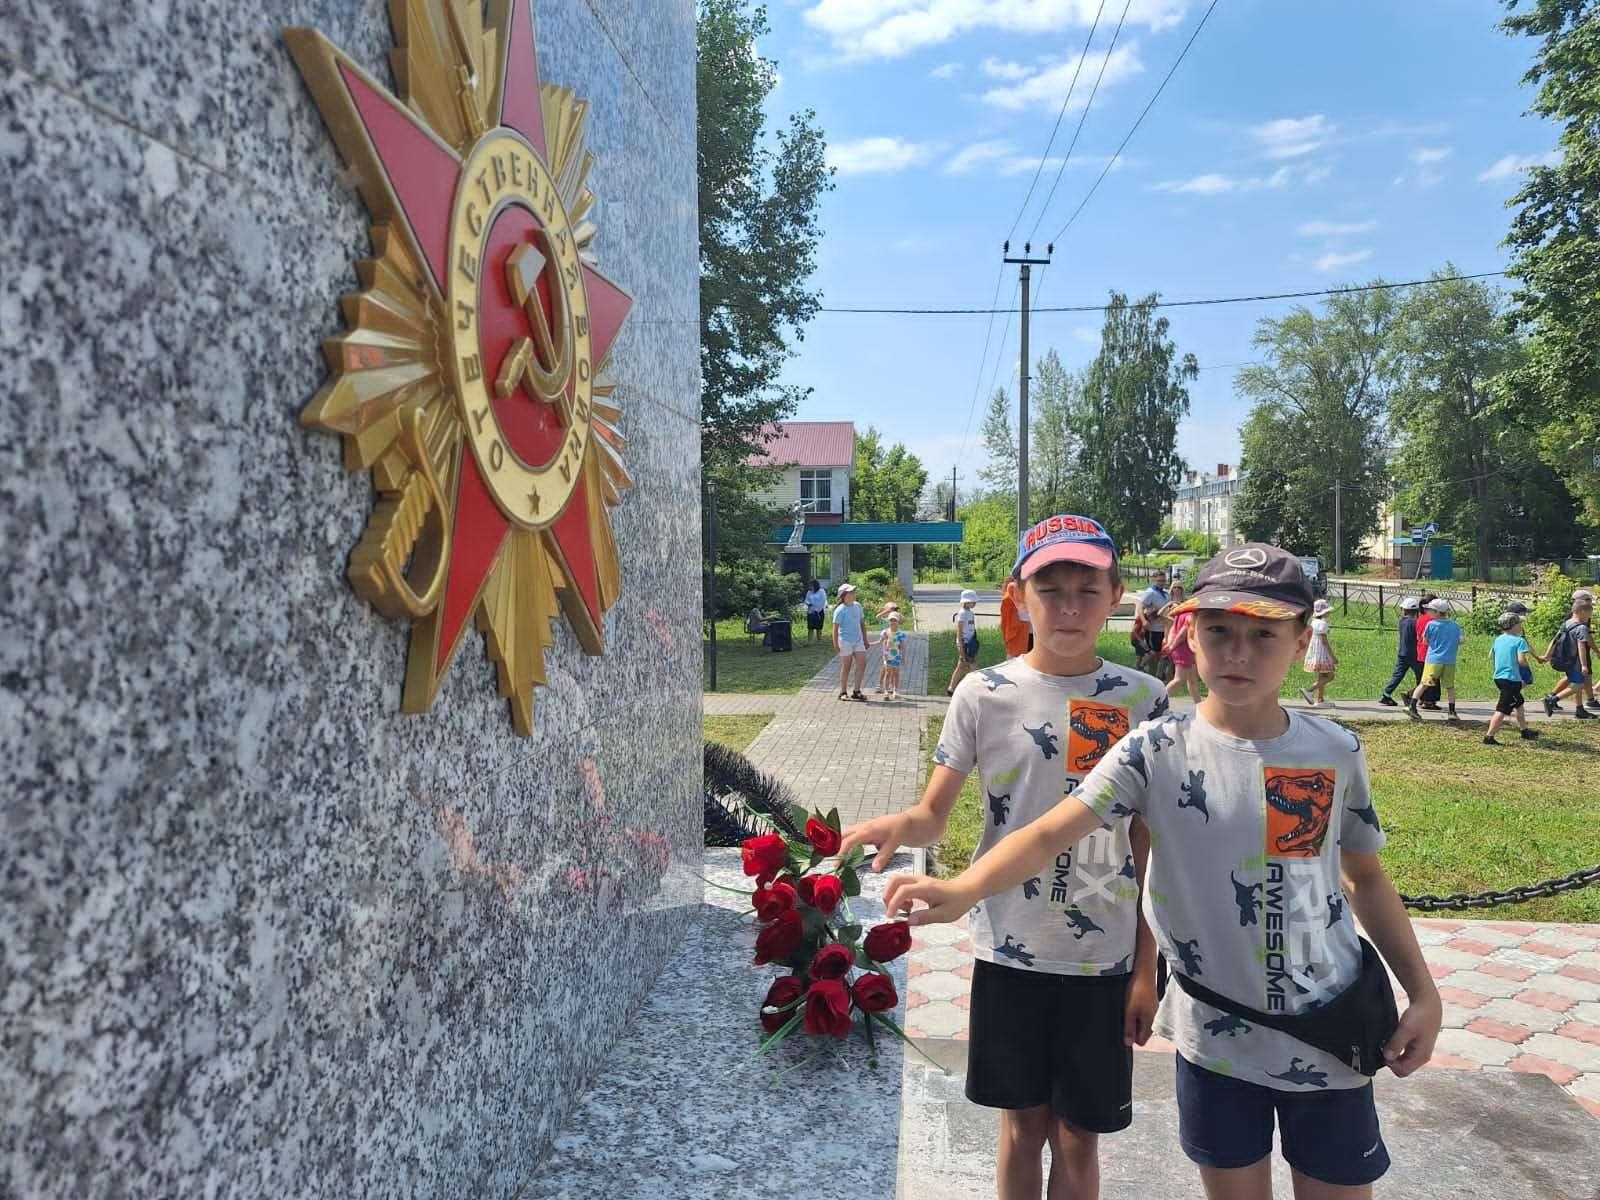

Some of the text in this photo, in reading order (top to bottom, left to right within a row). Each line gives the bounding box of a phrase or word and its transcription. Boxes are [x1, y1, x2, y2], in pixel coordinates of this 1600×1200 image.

[457, 151, 590, 484] ОТЕЧЕСТВЕННАЯ ВОЙНА
[1024, 517, 1101, 551] RUSSIA
[1266, 863, 1285, 1011] AWESOME
[1289, 863, 1338, 1014] REX
